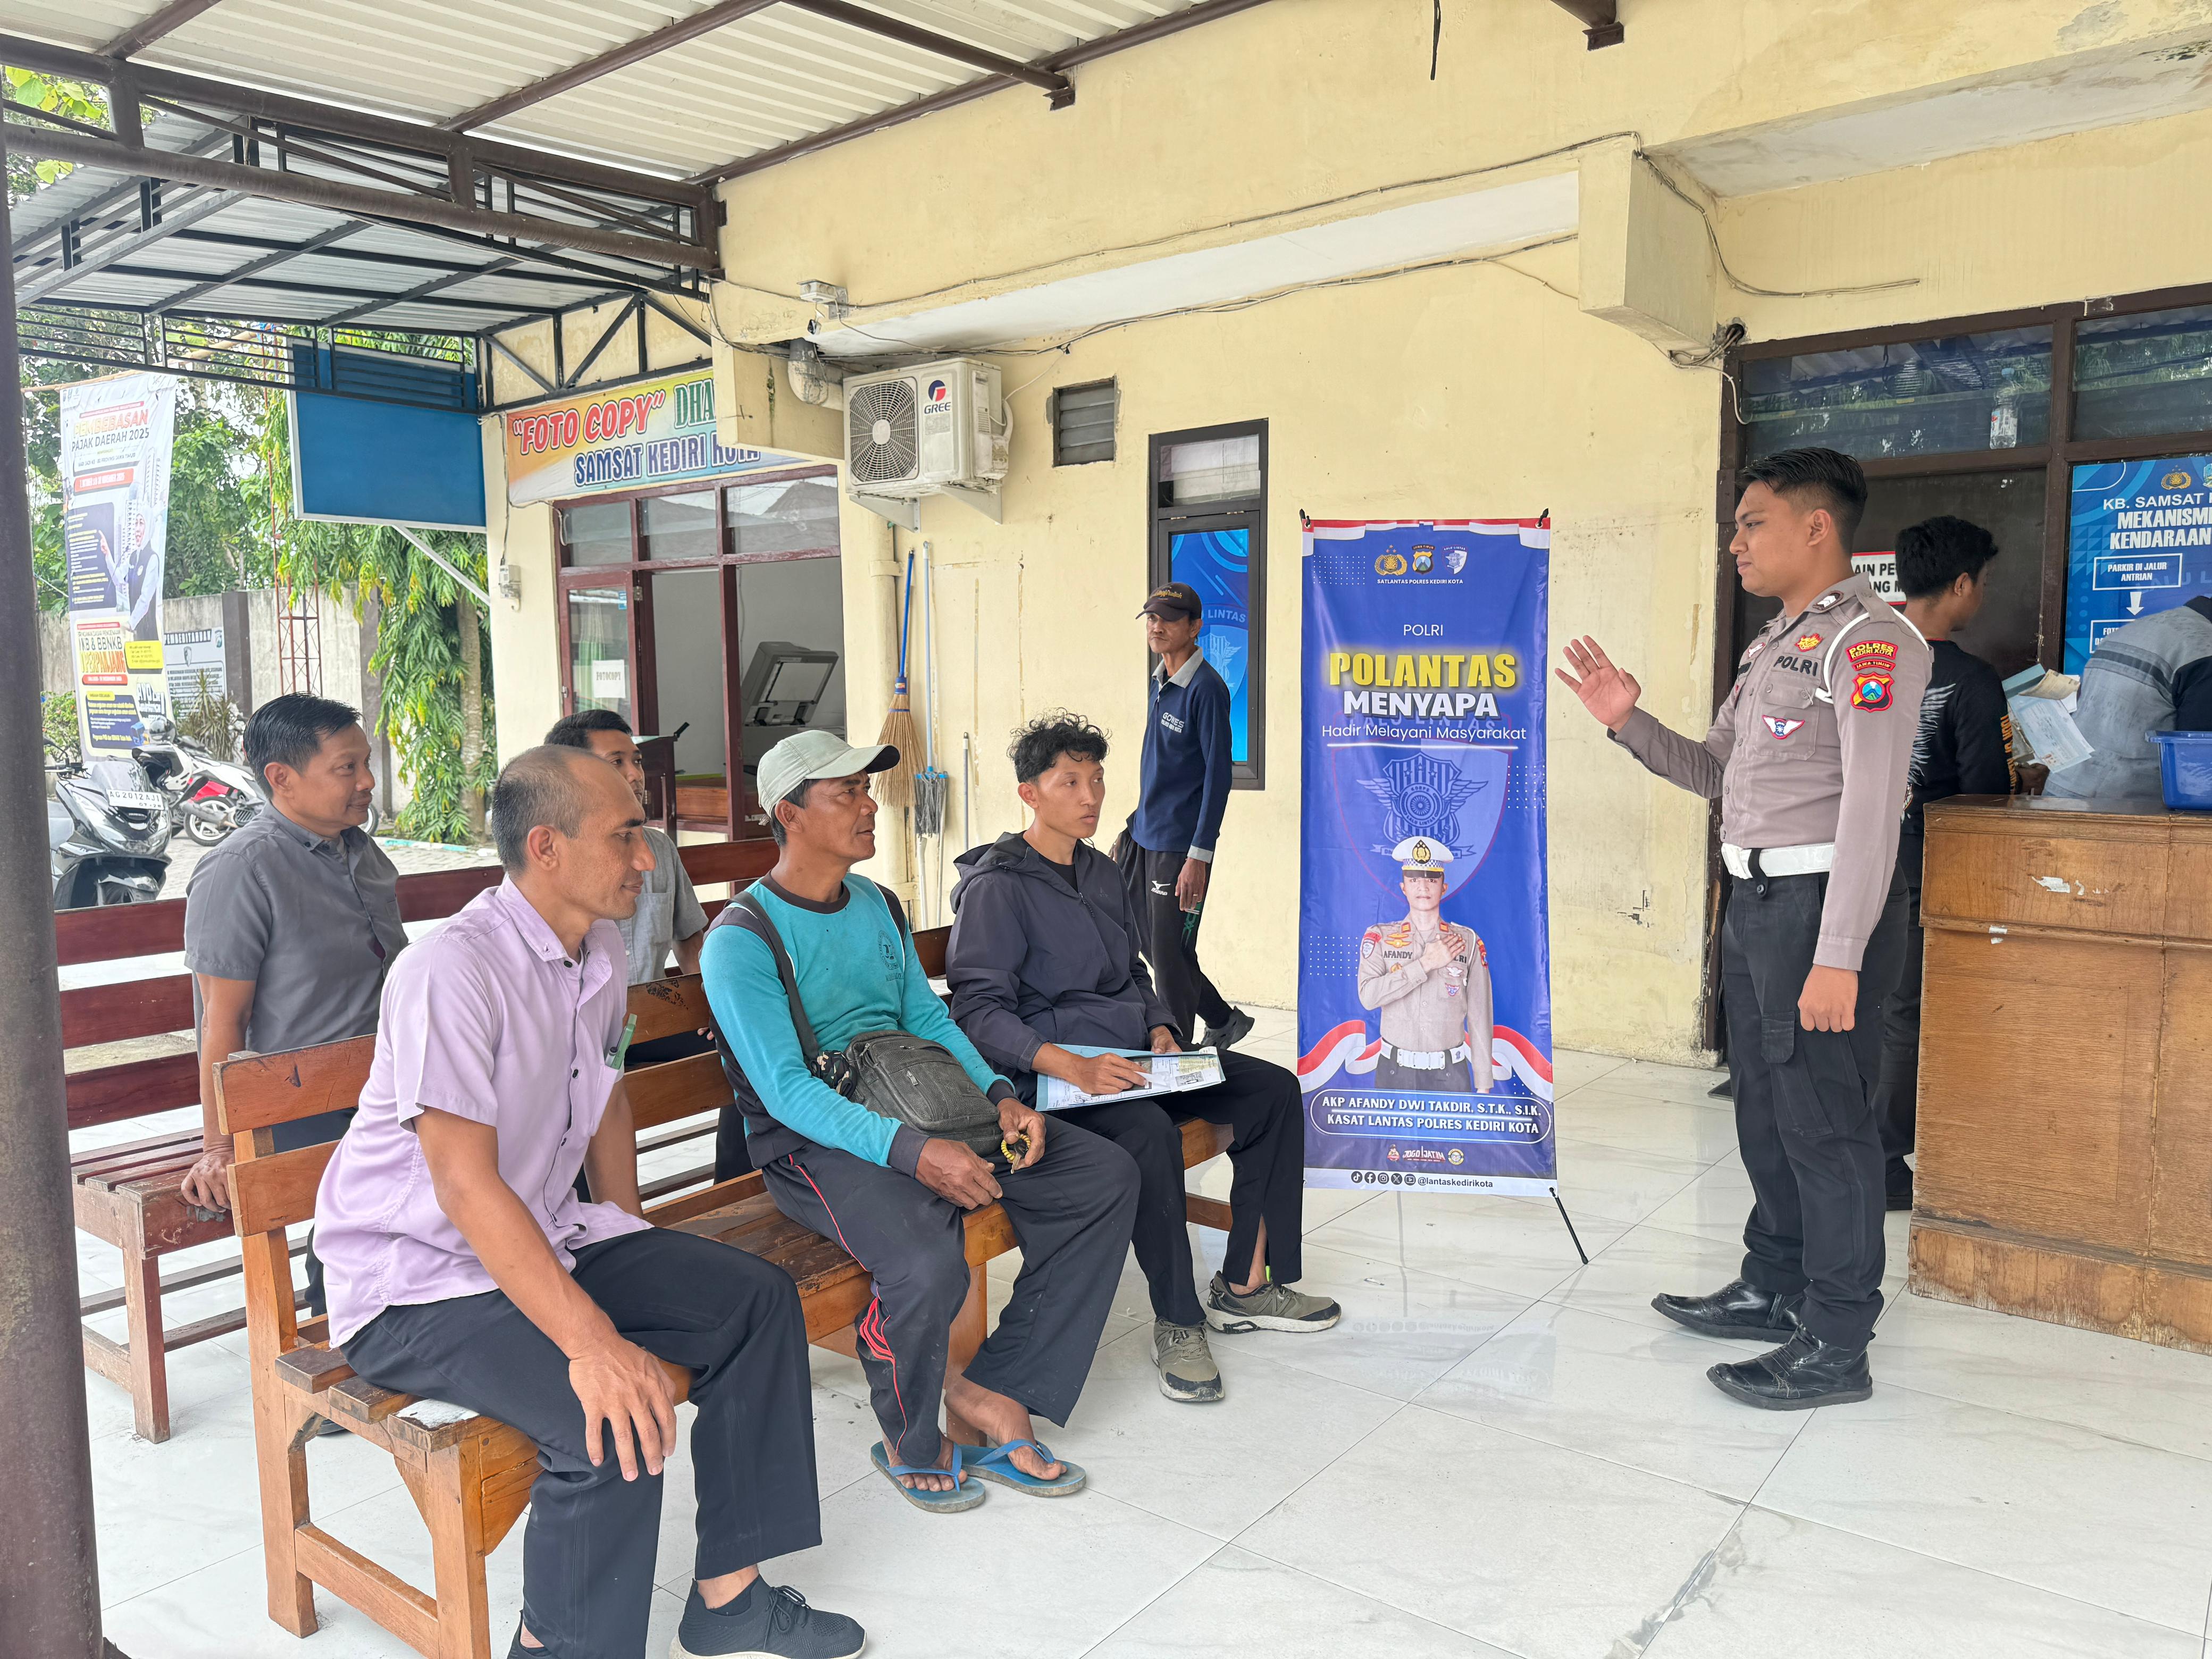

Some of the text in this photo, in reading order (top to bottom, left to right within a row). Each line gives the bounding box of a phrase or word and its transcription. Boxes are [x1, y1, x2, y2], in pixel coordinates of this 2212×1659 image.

[674, 380, 716, 429] DHA
[924, 401, 951, 414] GREE
[73, 408, 148, 439] PEMBEBASAN
[72, 437, 93, 452] PAJAK
[95, 431, 128, 447] DAERAH
[129, 428, 149, 440] 2025
[574, 443, 642, 487] SAMSAT
[647, 433, 705, 476] KEDIRI
[2103, 499, 2130, 510] KB.
[2135, 492, 2204, 508] SAMSAT
[2109, 527, 2211, 550] KENDARAAN
[1855, 563, 1895, 576] AIN PE
[2107, 562, 2167, 572] PARKIR DI JALUR
[2121, 573, 2152, 582] ANTRIAN
[1208, 609, 1246, 623] LINTAS
[1403, 624, 1443, 636] POLRI
[97, 636, 122, 650] BBNKB
[1849, 643, 1894, 655] POLRES
[1851, 648, 1892, 659] KEDIRI KOTA
[1329, 653, 1516, 688] POLANTAS
[1773, 655, 1818, 676] POLRI
[596, 672, 621, 681] FOTOCOPY
[1343, 690, 1499, 718] MENYAPA
[1322, 724, 1527, 742] Hadir Melayani Masyarakat
[1384, 950, 1413, 959] AFANDY
[1322, 1096, 1345, 1107] AKP
[1348, 1097, 1395, 1109] AFANDY
[1399, 1099, 1425, 1111] DWI
[1515, 1105, 1541, 1116] S.I.K.
[1327, 1114, 1539, 1134] KASAT LANTAS POLRES KEDIRI KOTA
[1418, 1177, 1493, 1188] @lantaskedirikota
